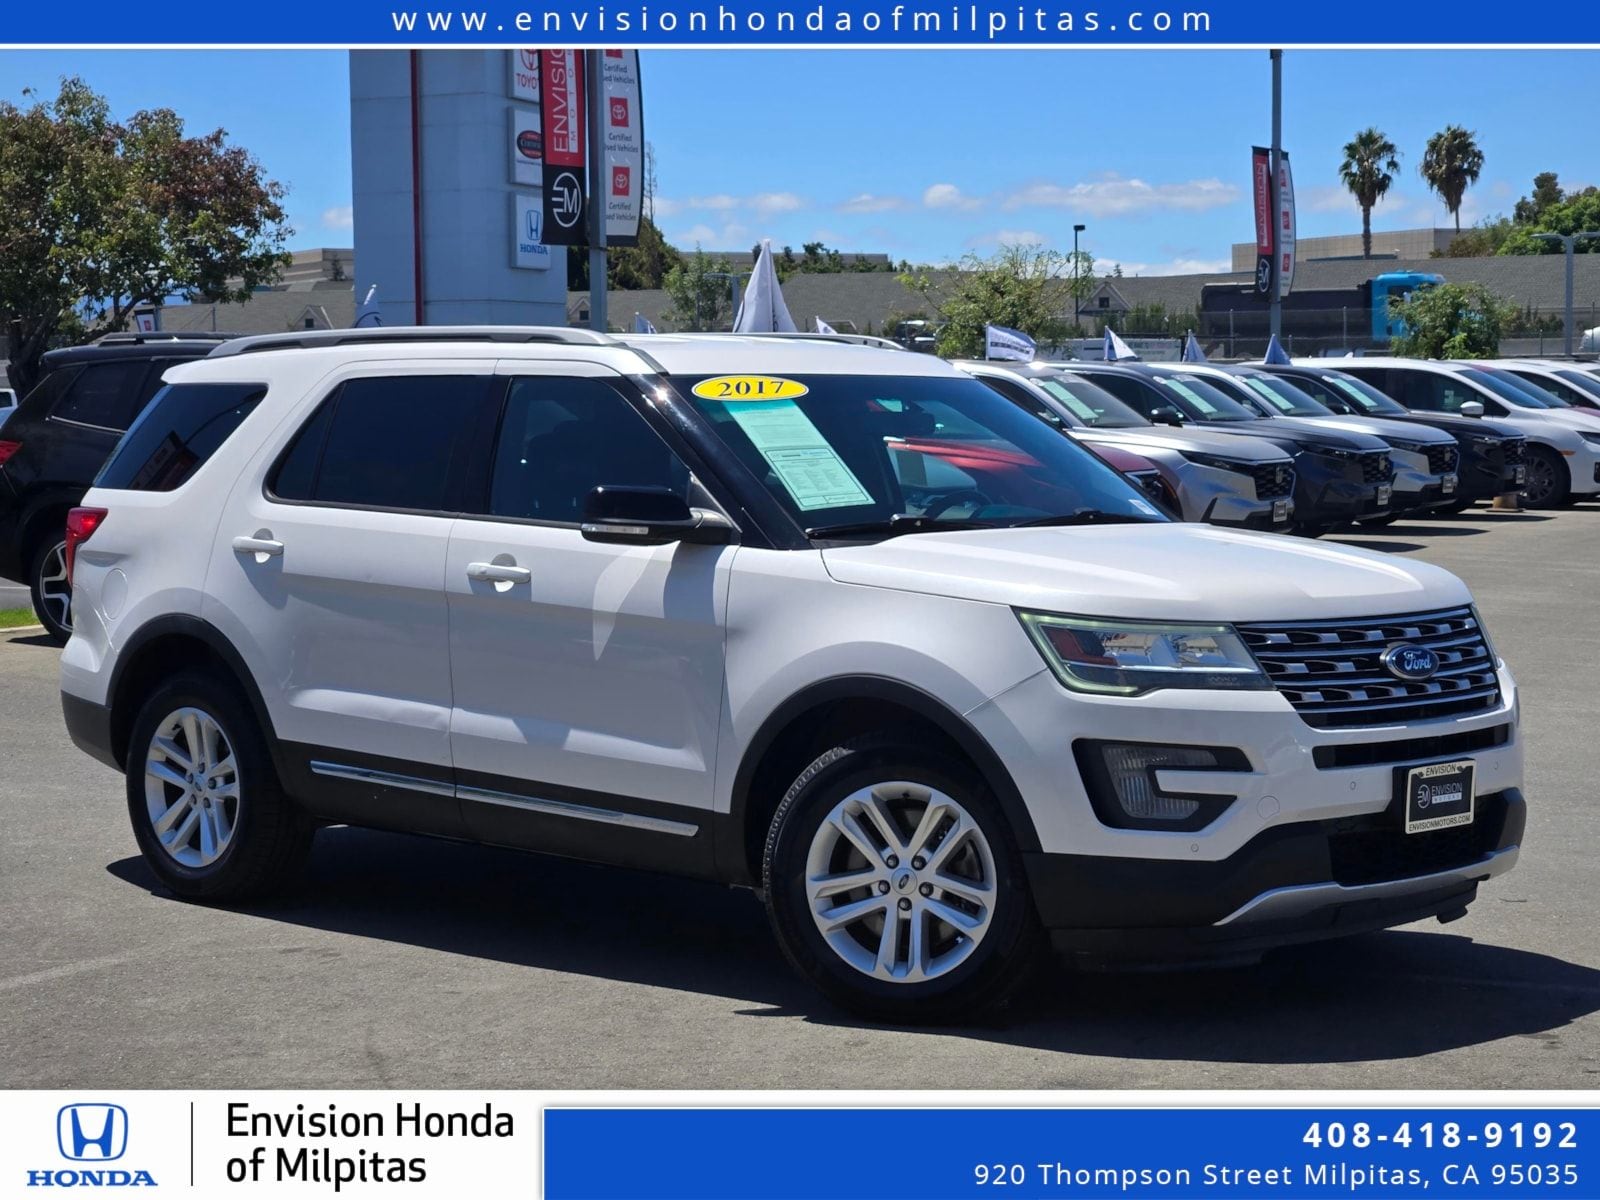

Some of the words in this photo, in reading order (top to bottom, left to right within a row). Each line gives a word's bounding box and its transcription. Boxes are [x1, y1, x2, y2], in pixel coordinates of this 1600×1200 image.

[604, 63, 628, 73] Certified
[516, 72, 539, 90] TOYO
[550, 49, 568, 152] ENVISIO
[608, 132, 633, 142] Certified
[608, 201, 632, 210] Certified
[519, 243, 549, 256] HONDA
[717, 380, 785, 397] 2017
[1403, 650, 1433, 671] Ford
[1425, 764, 1457, 777] ENVISION
[1431, 782, 1463, 796] ENVISION
[1408, 814, 1471, 832] ENVISIONMOTORS.COM
